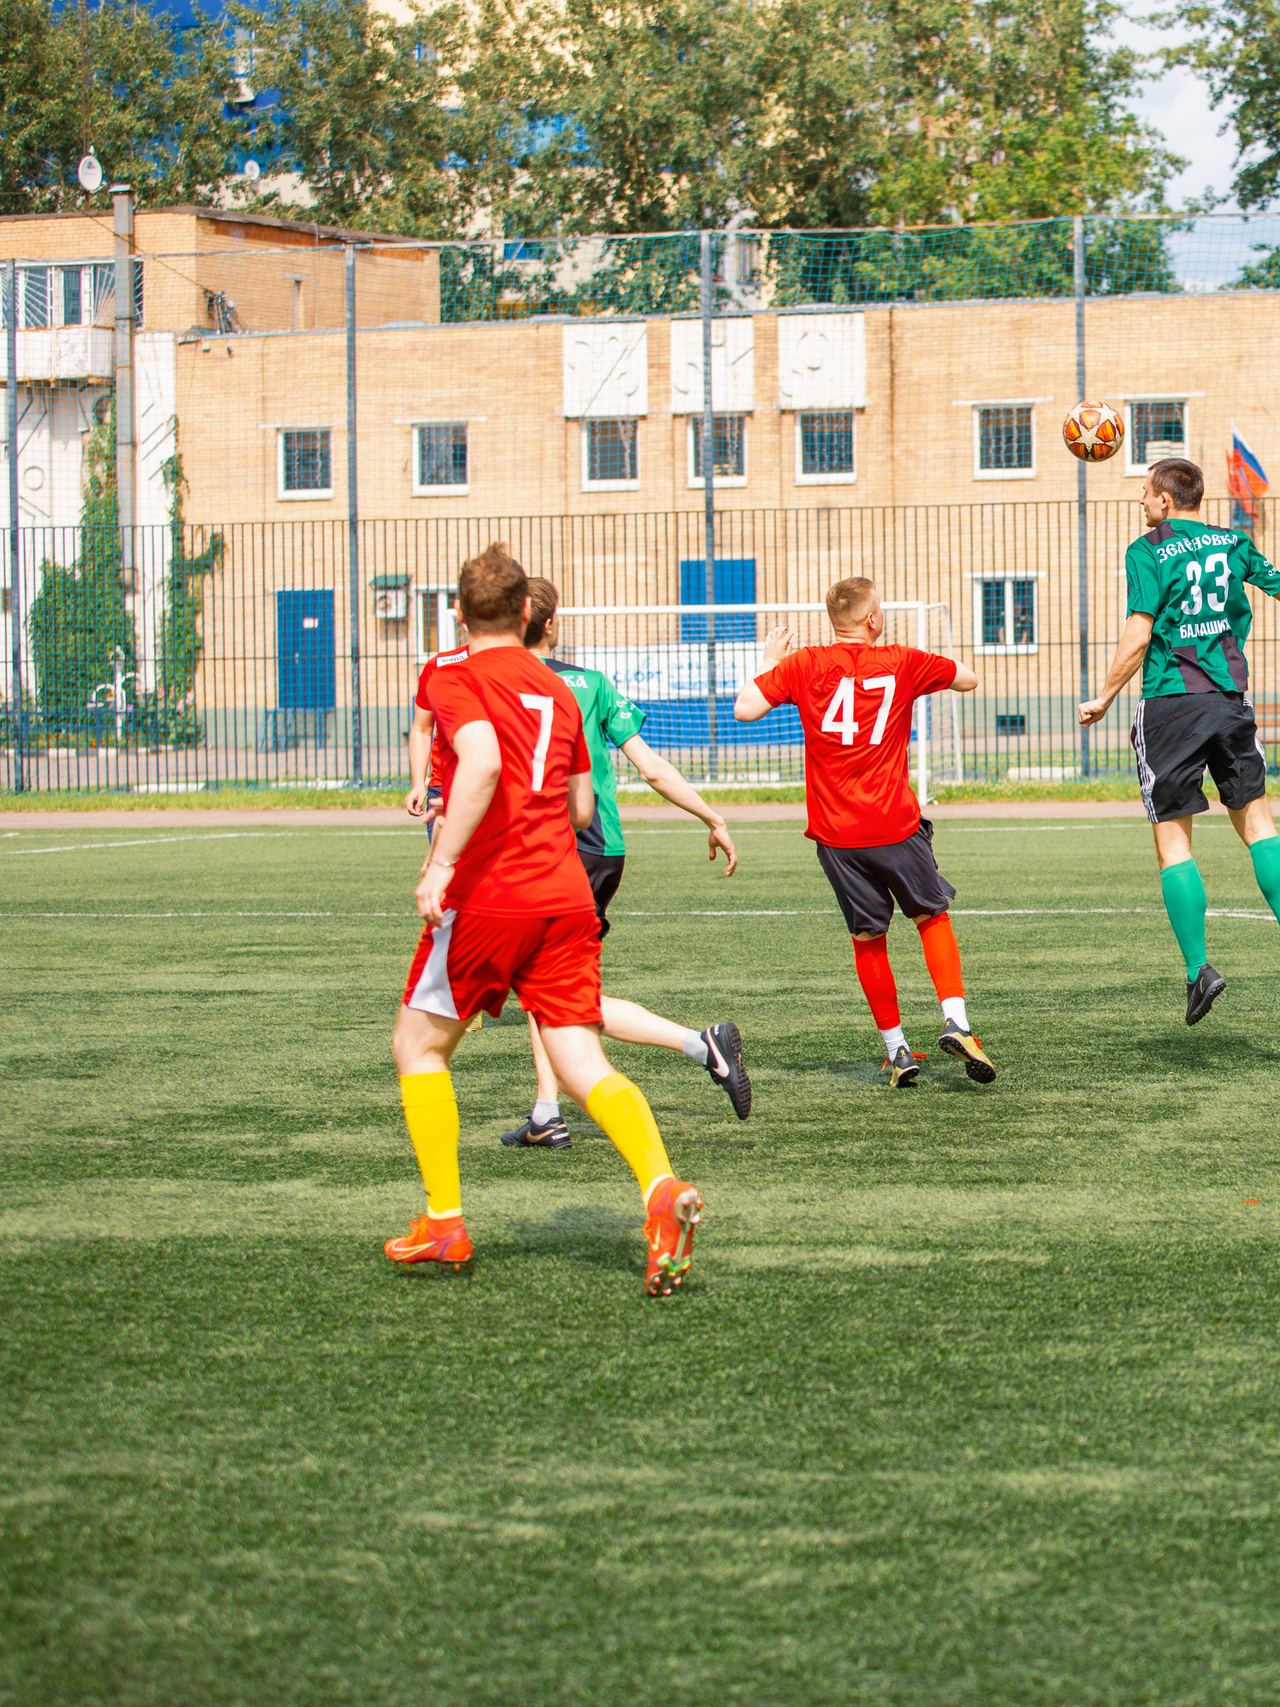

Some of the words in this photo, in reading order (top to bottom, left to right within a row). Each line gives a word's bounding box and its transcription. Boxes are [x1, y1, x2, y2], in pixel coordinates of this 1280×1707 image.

[1181, 552, 1231, 616] 33
[518, 692, 554, 792] 7
[821, 674, 896, 745] 47
